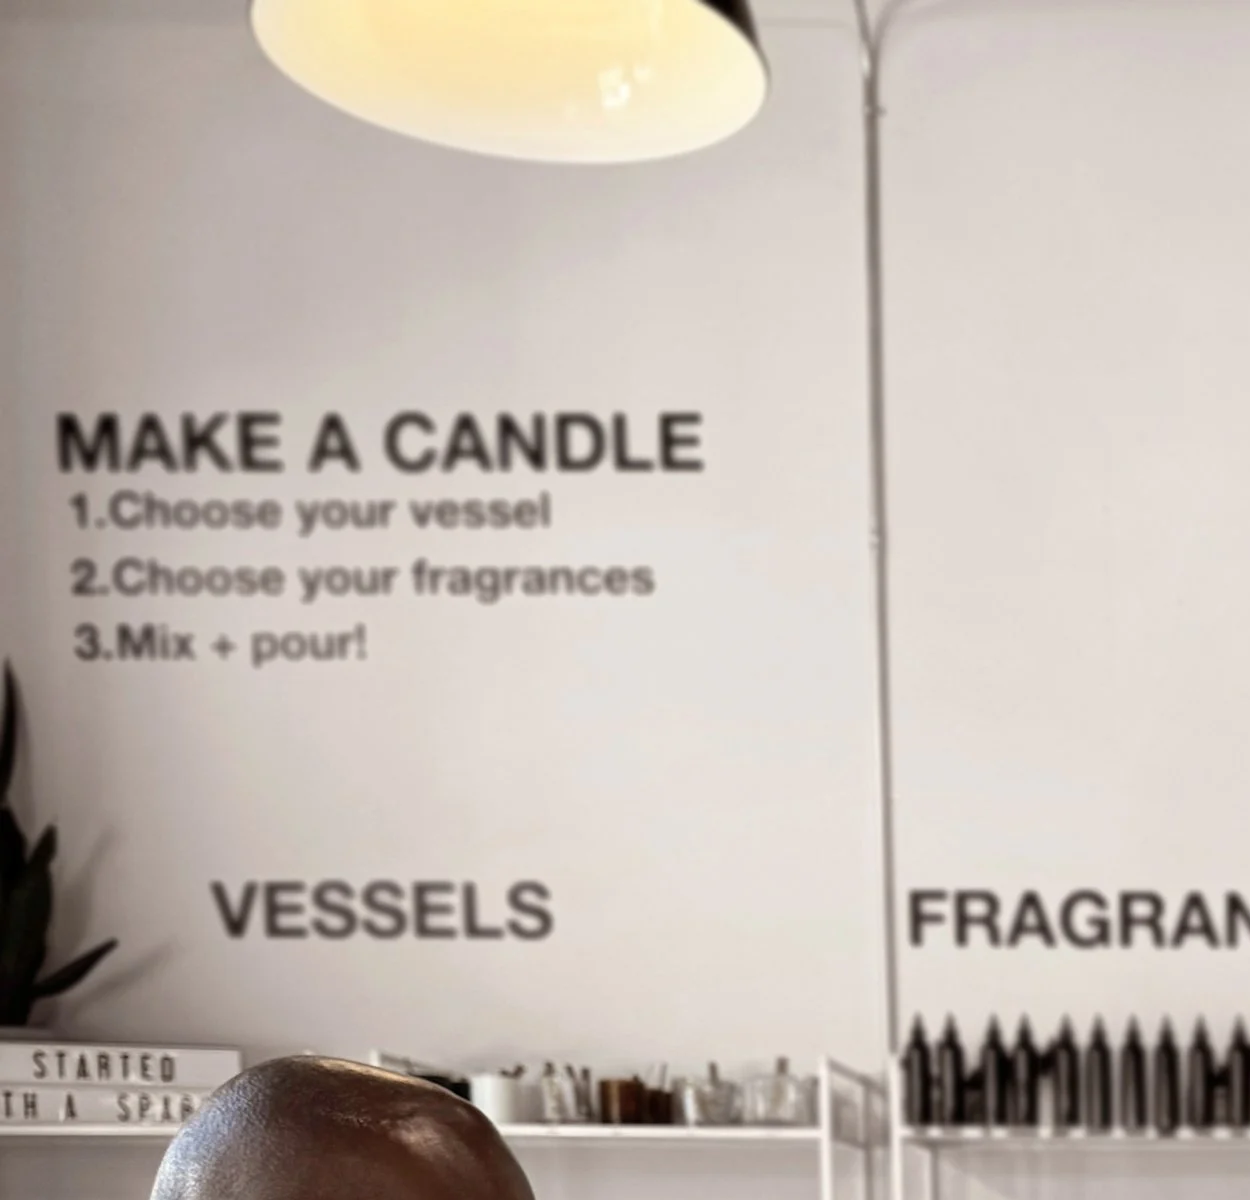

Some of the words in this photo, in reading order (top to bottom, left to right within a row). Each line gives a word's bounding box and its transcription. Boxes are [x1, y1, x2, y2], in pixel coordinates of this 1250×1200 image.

[56, 411, 283, 473] MAKE
[308, 412, 361, 472] A
[384, 411, 704, 474] CANDLE
[69, 489, 283, 530] 1.Choose
[295, 499, 397, 538] your
[409, 491, 552, 530] vessel
[70, 556, 286, 597] 2.Choose
[298, 566, 399, 604] your
[410, 557, 656, 605] fragrances
[75, 623, 194, 662] 3.Mix
[250, 623, 367, 669] pour!
[210, 880, 554, 941] VESSELS
[32, 1050, 176, 1083] STARTED
[65, 1092, 77, 1119] A
